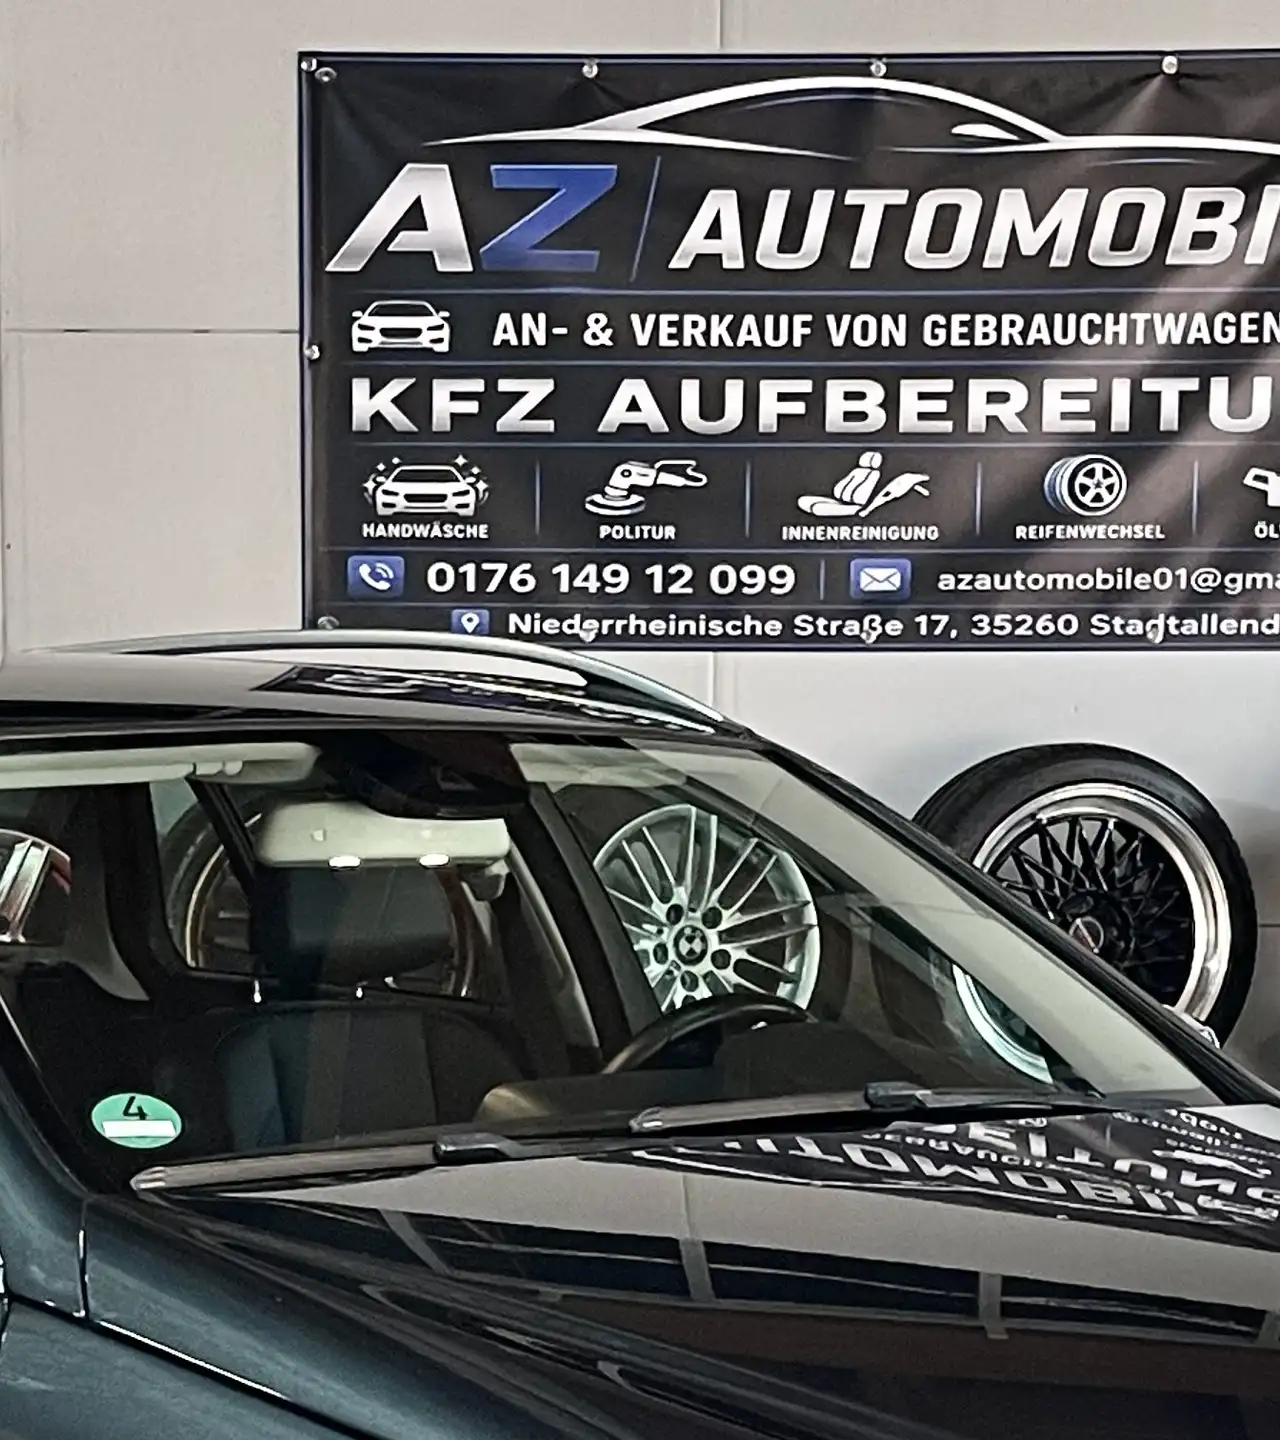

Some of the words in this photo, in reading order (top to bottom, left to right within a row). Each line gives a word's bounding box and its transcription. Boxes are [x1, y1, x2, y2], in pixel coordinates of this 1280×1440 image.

[324, 162, 618, 273] AZ
[492, 312, 569, 347] AN-
[583, 312, 614, 347] &
[630, 313, 813, 348] VERKAUF
[825, 313, 907, 347] VON
[350, 377, 556, 433] KFZ
[362, 520, 489, 540] HANDWÄSCHE
[598, 524, 677, 541] POLITUR
[781, 525, 940, 542] INNENREINIGUNG
[1015, 523, 1166, 541] REIFENWECHSEL
[426, 561, 538, 594] 0176
[551, 562, 631, 595] 149
[645, 563, 695, 595] 12
[709, 564, 797, 596] 099
[508, 612, 783, 638] Niederrheinische
[792, 614, 905, 641] Straße
[914, 614, 958, 640] 17,
[971, 613, 1079, 637] 35260
[122, 1095, 149, 1121] 4
